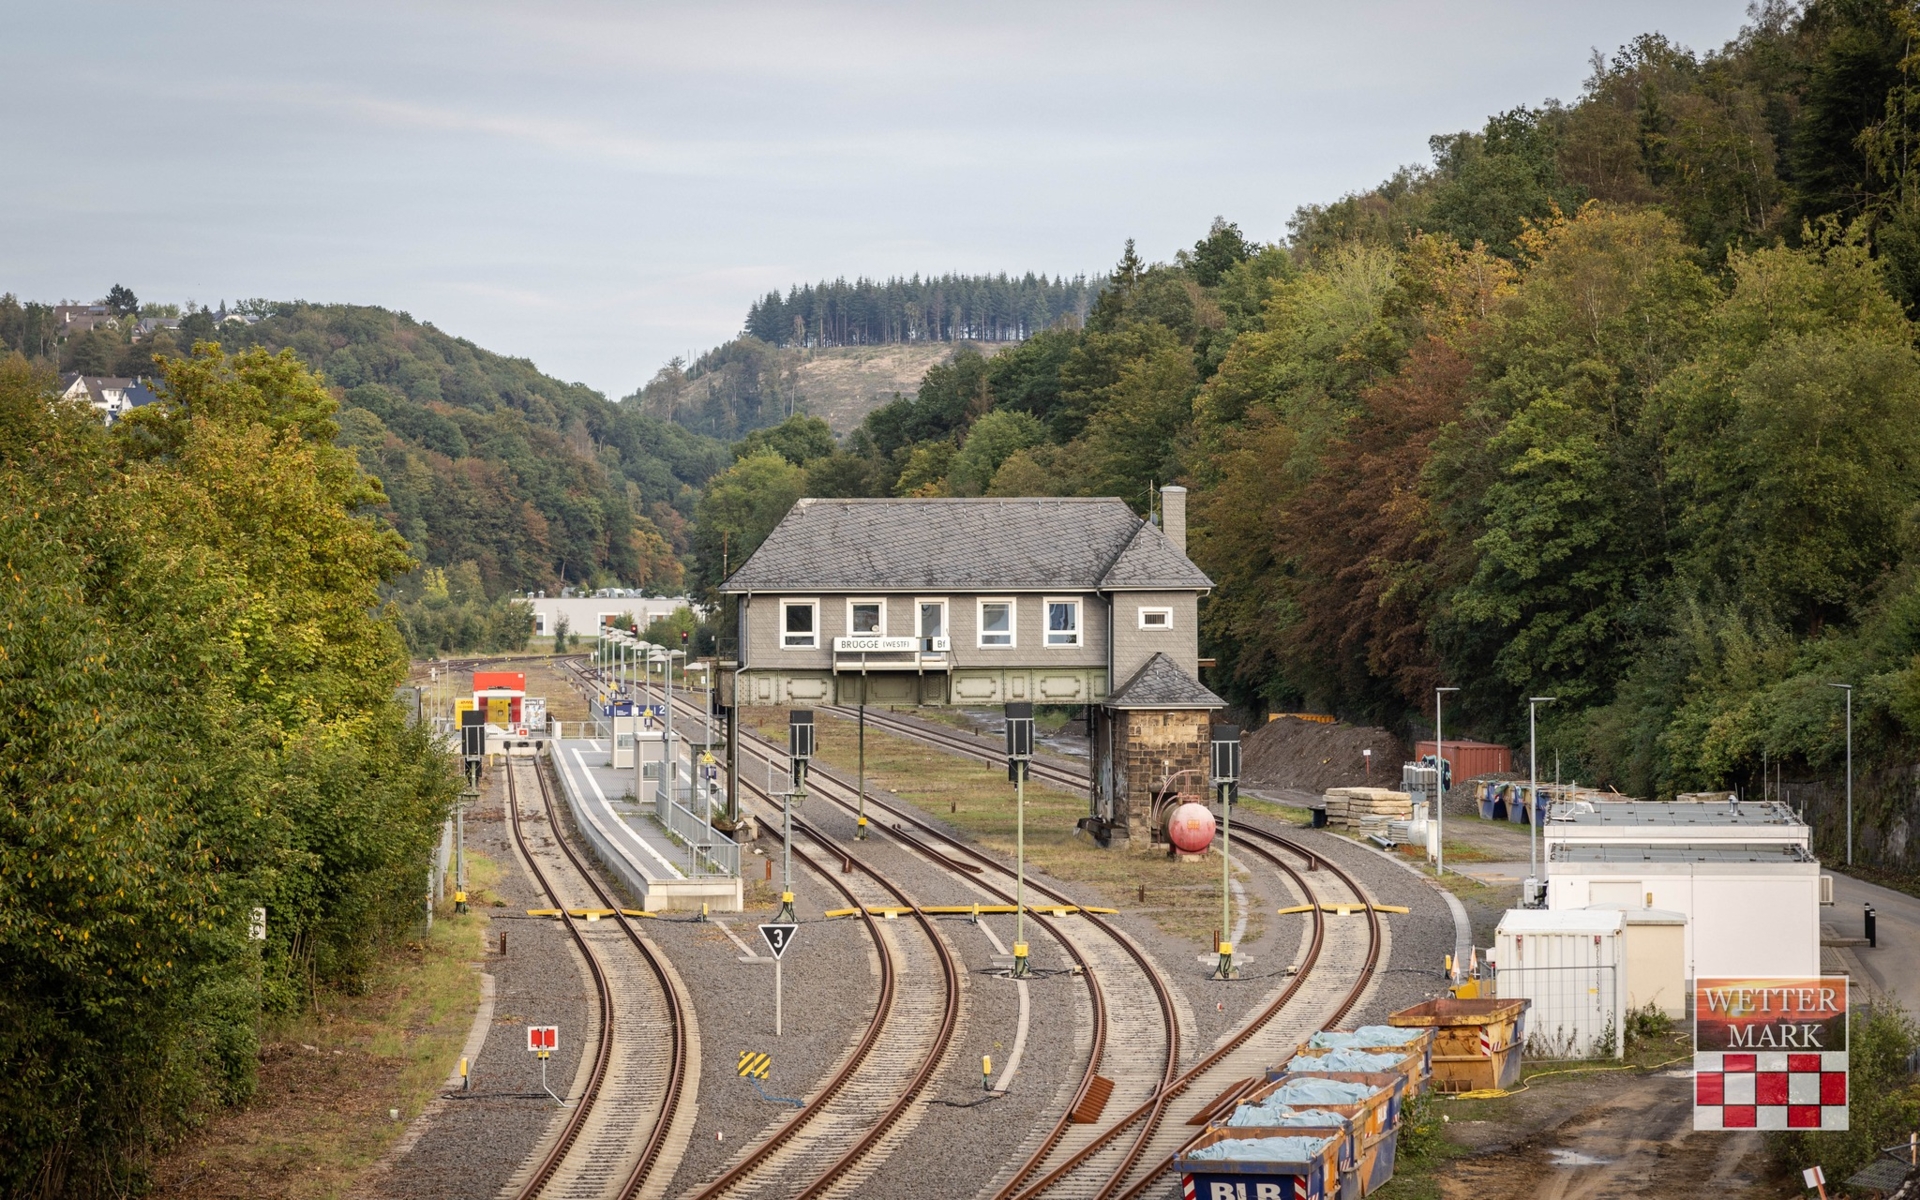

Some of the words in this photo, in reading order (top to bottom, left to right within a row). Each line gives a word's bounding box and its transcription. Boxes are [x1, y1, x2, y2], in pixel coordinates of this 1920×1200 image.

[937, 640, 945, 648] Bf
[604, 706, 610, 715] 1
[658, 705, 666, 715] 2
[773, 928, 784, 949] 3
